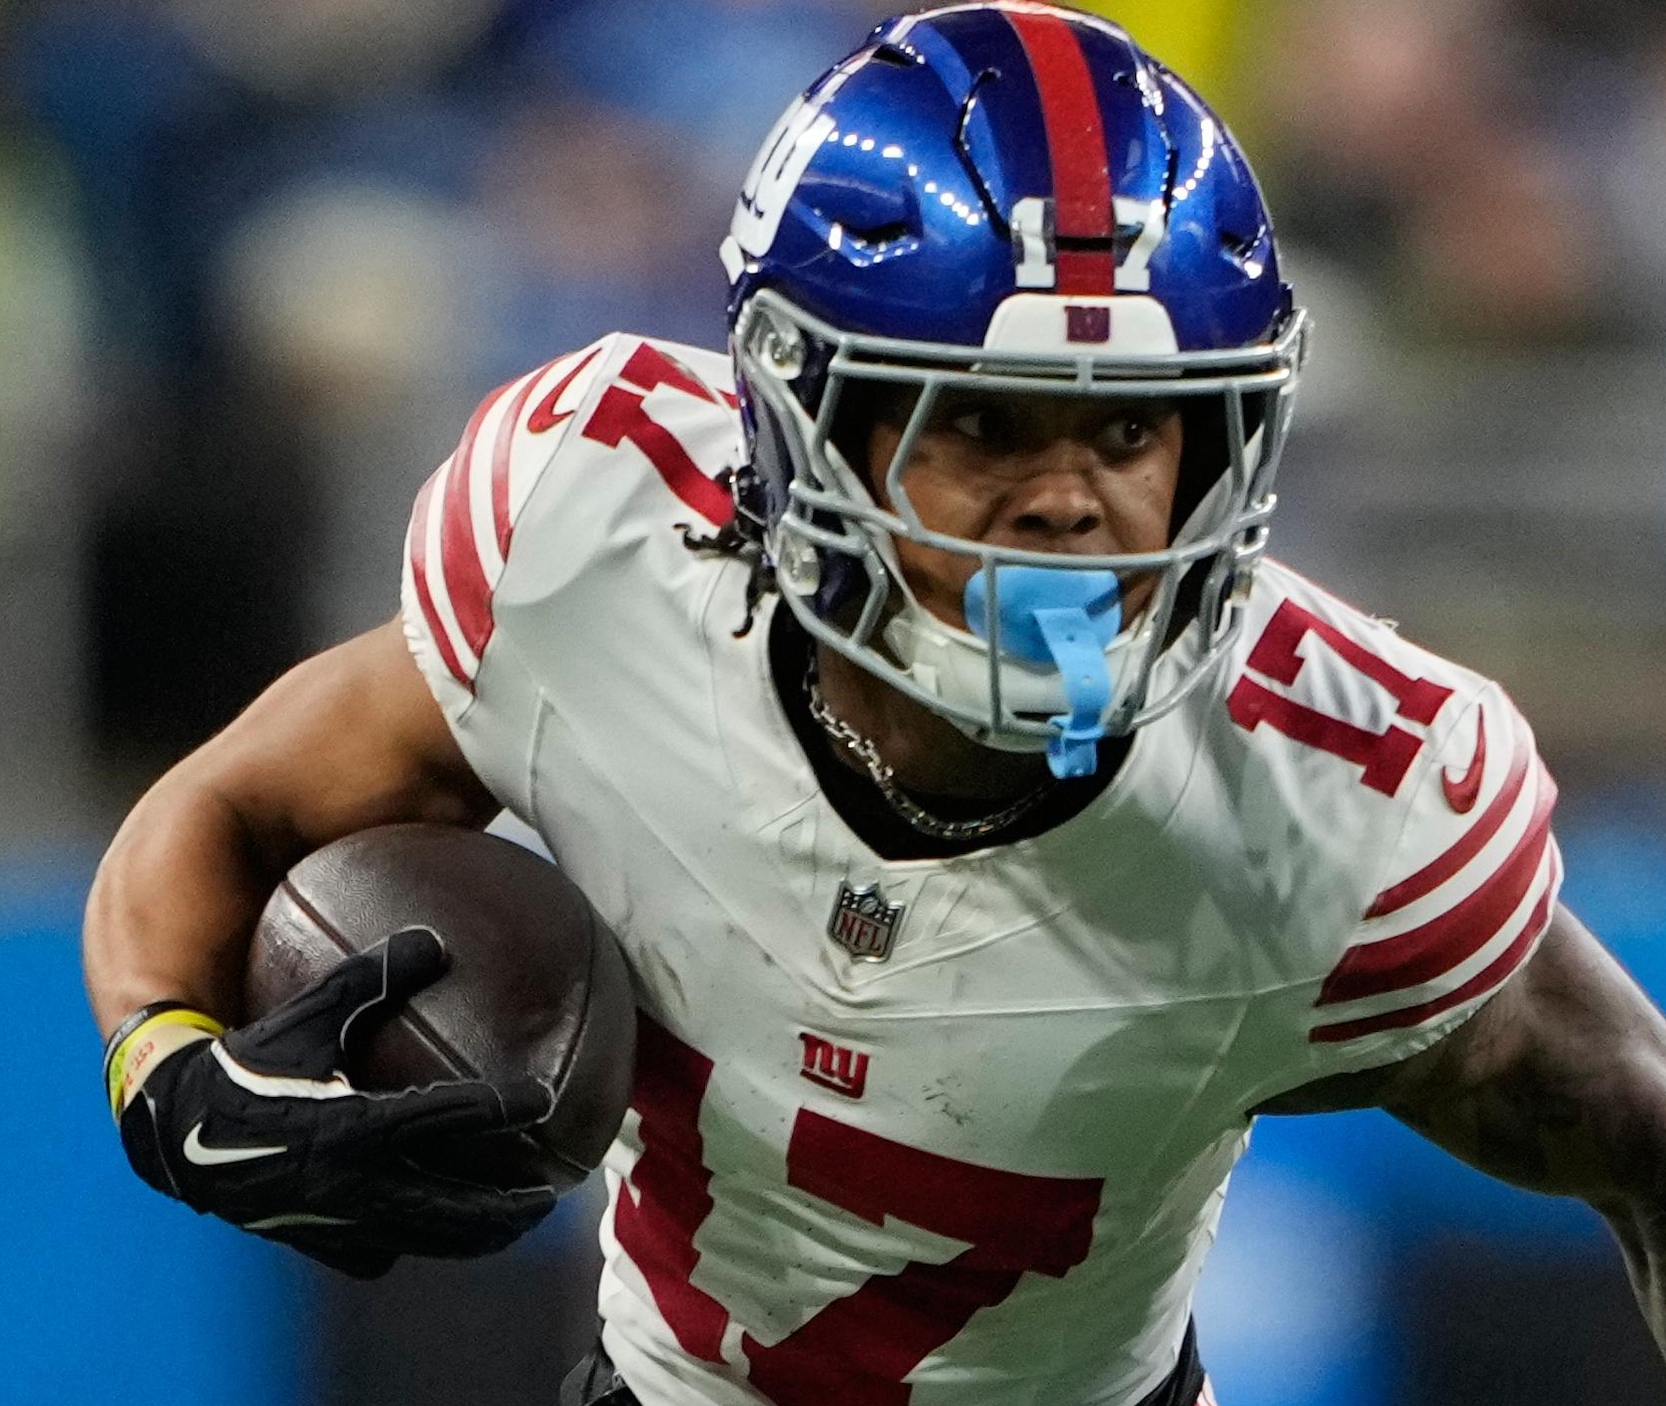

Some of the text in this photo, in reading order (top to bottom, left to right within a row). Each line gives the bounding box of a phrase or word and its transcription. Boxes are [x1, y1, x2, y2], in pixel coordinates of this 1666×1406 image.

[1011, 196, 1166, 292] 17
[1226, 597, 1455, 799] 17
[836, 909, 883, 955] NFL
